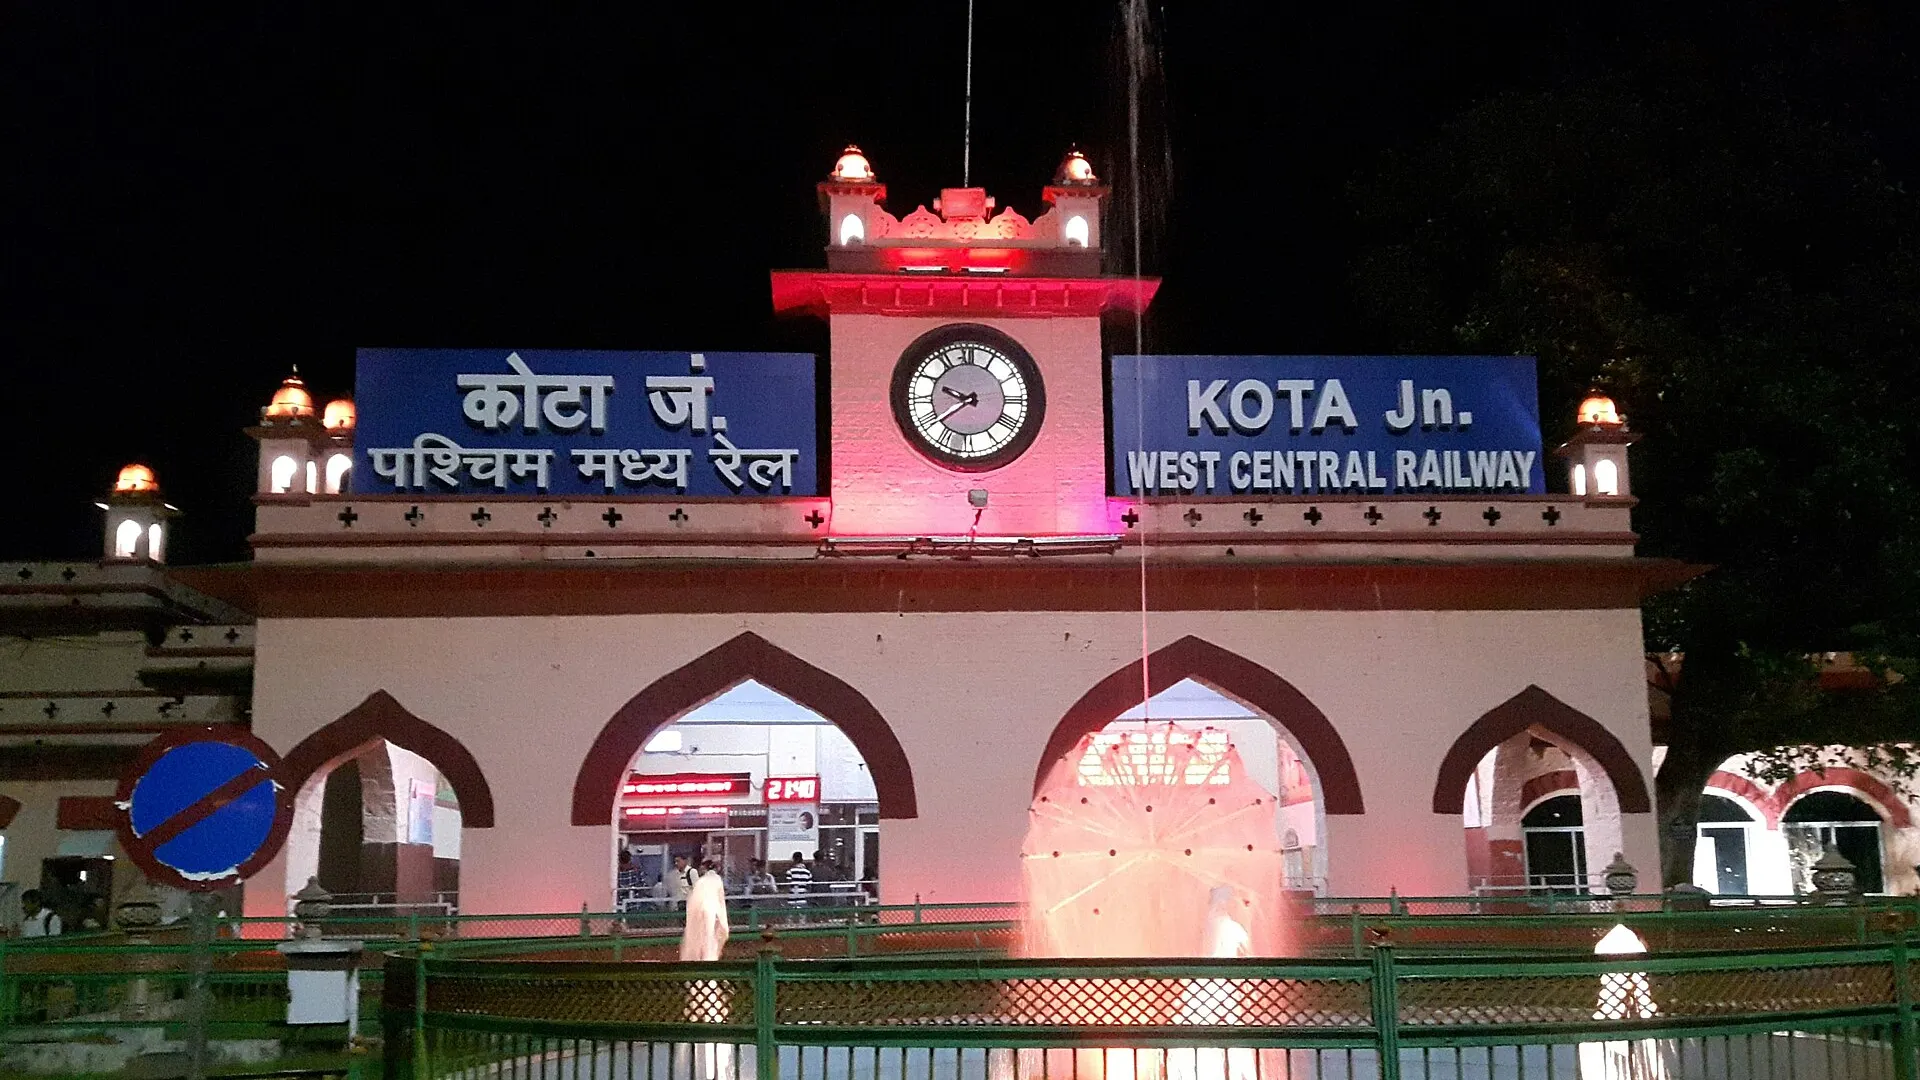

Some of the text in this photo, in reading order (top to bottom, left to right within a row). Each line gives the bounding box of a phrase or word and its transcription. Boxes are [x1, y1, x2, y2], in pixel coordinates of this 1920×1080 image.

[457, 352, 727, 433] कोटा जं.
[1187, 379, 1473, 432] KOTA Jn.
[367, 432, 799, 488] पश्चिम मध्य रेल
[1128, 449, 1537, 490] WEST CENTRAL RAILWAY
